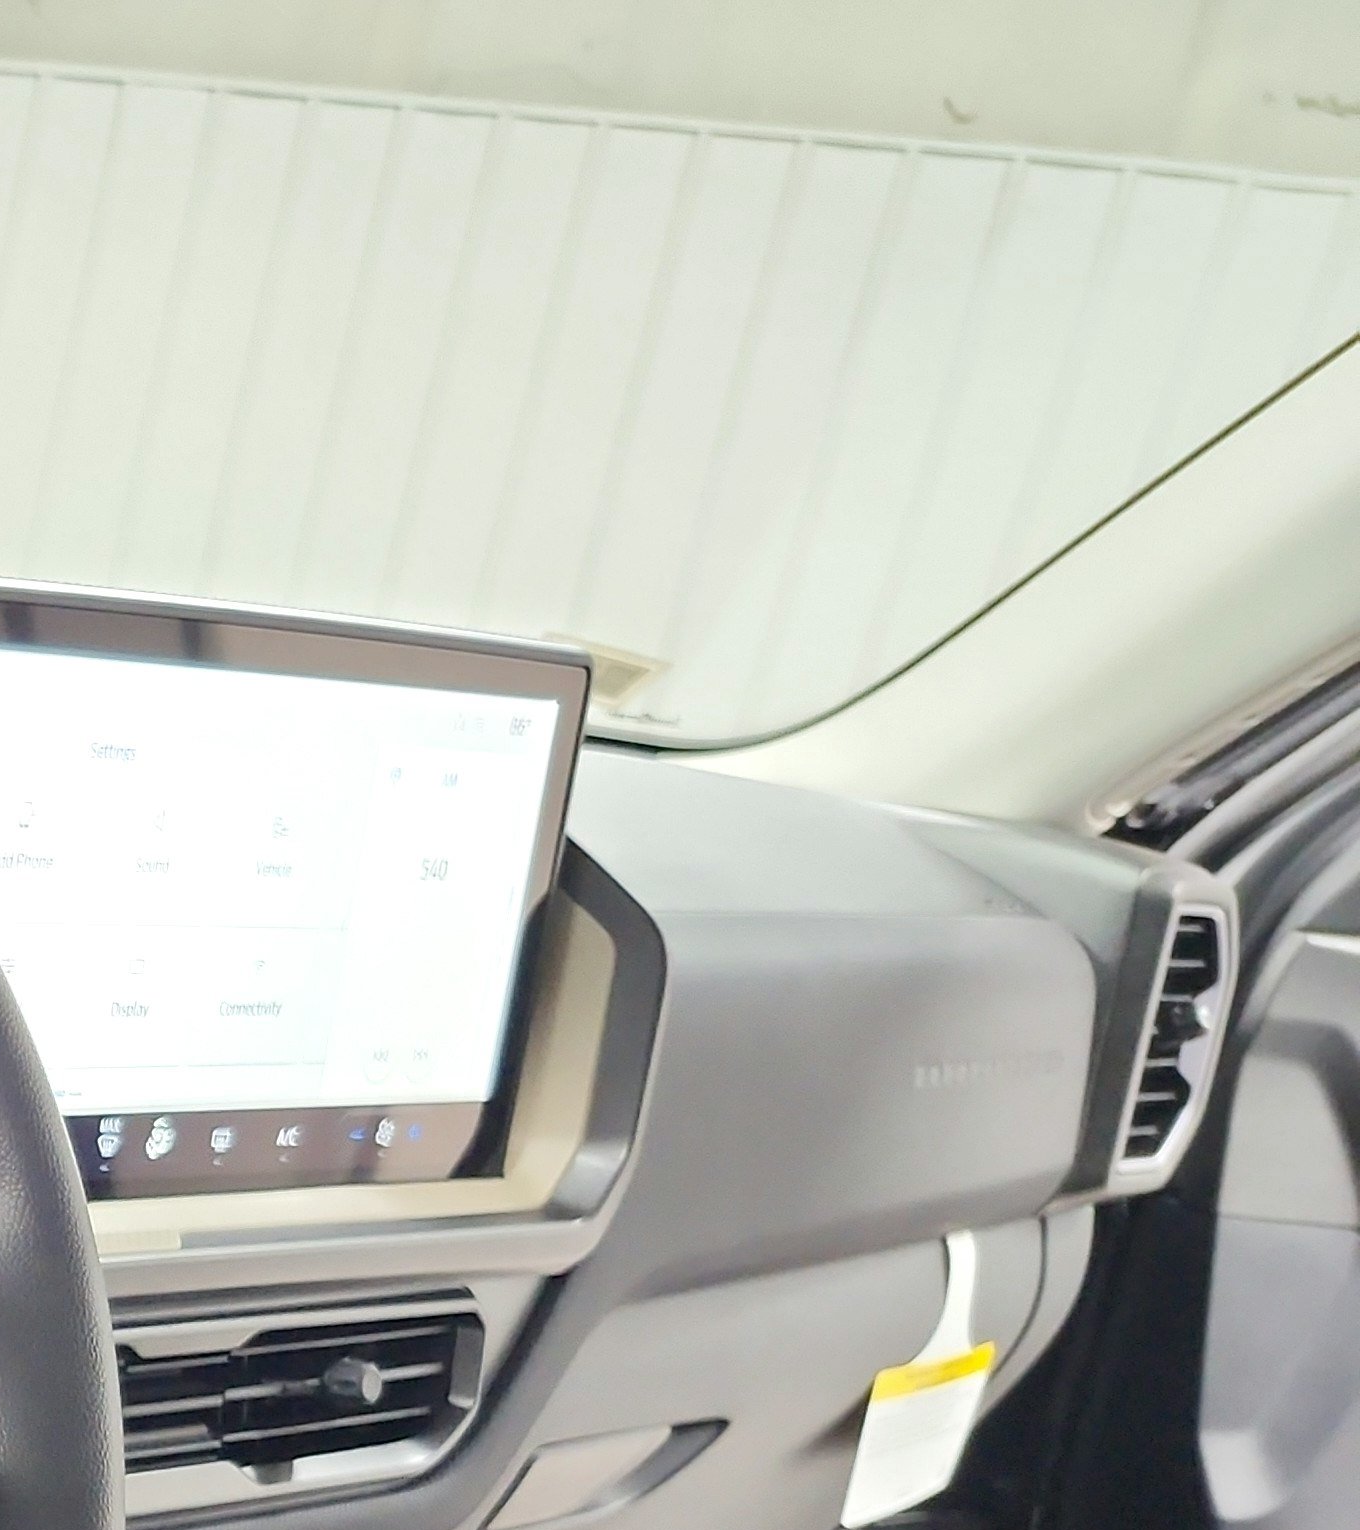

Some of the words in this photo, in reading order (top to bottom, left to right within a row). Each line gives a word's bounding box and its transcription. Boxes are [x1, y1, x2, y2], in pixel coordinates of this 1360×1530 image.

[90, 742, 137, 761] Settings
[135, 857, 170, 874] Sound
[111, 1000, 150, 1019] Display
[218, 1000, 284, 1019] Connectivity
